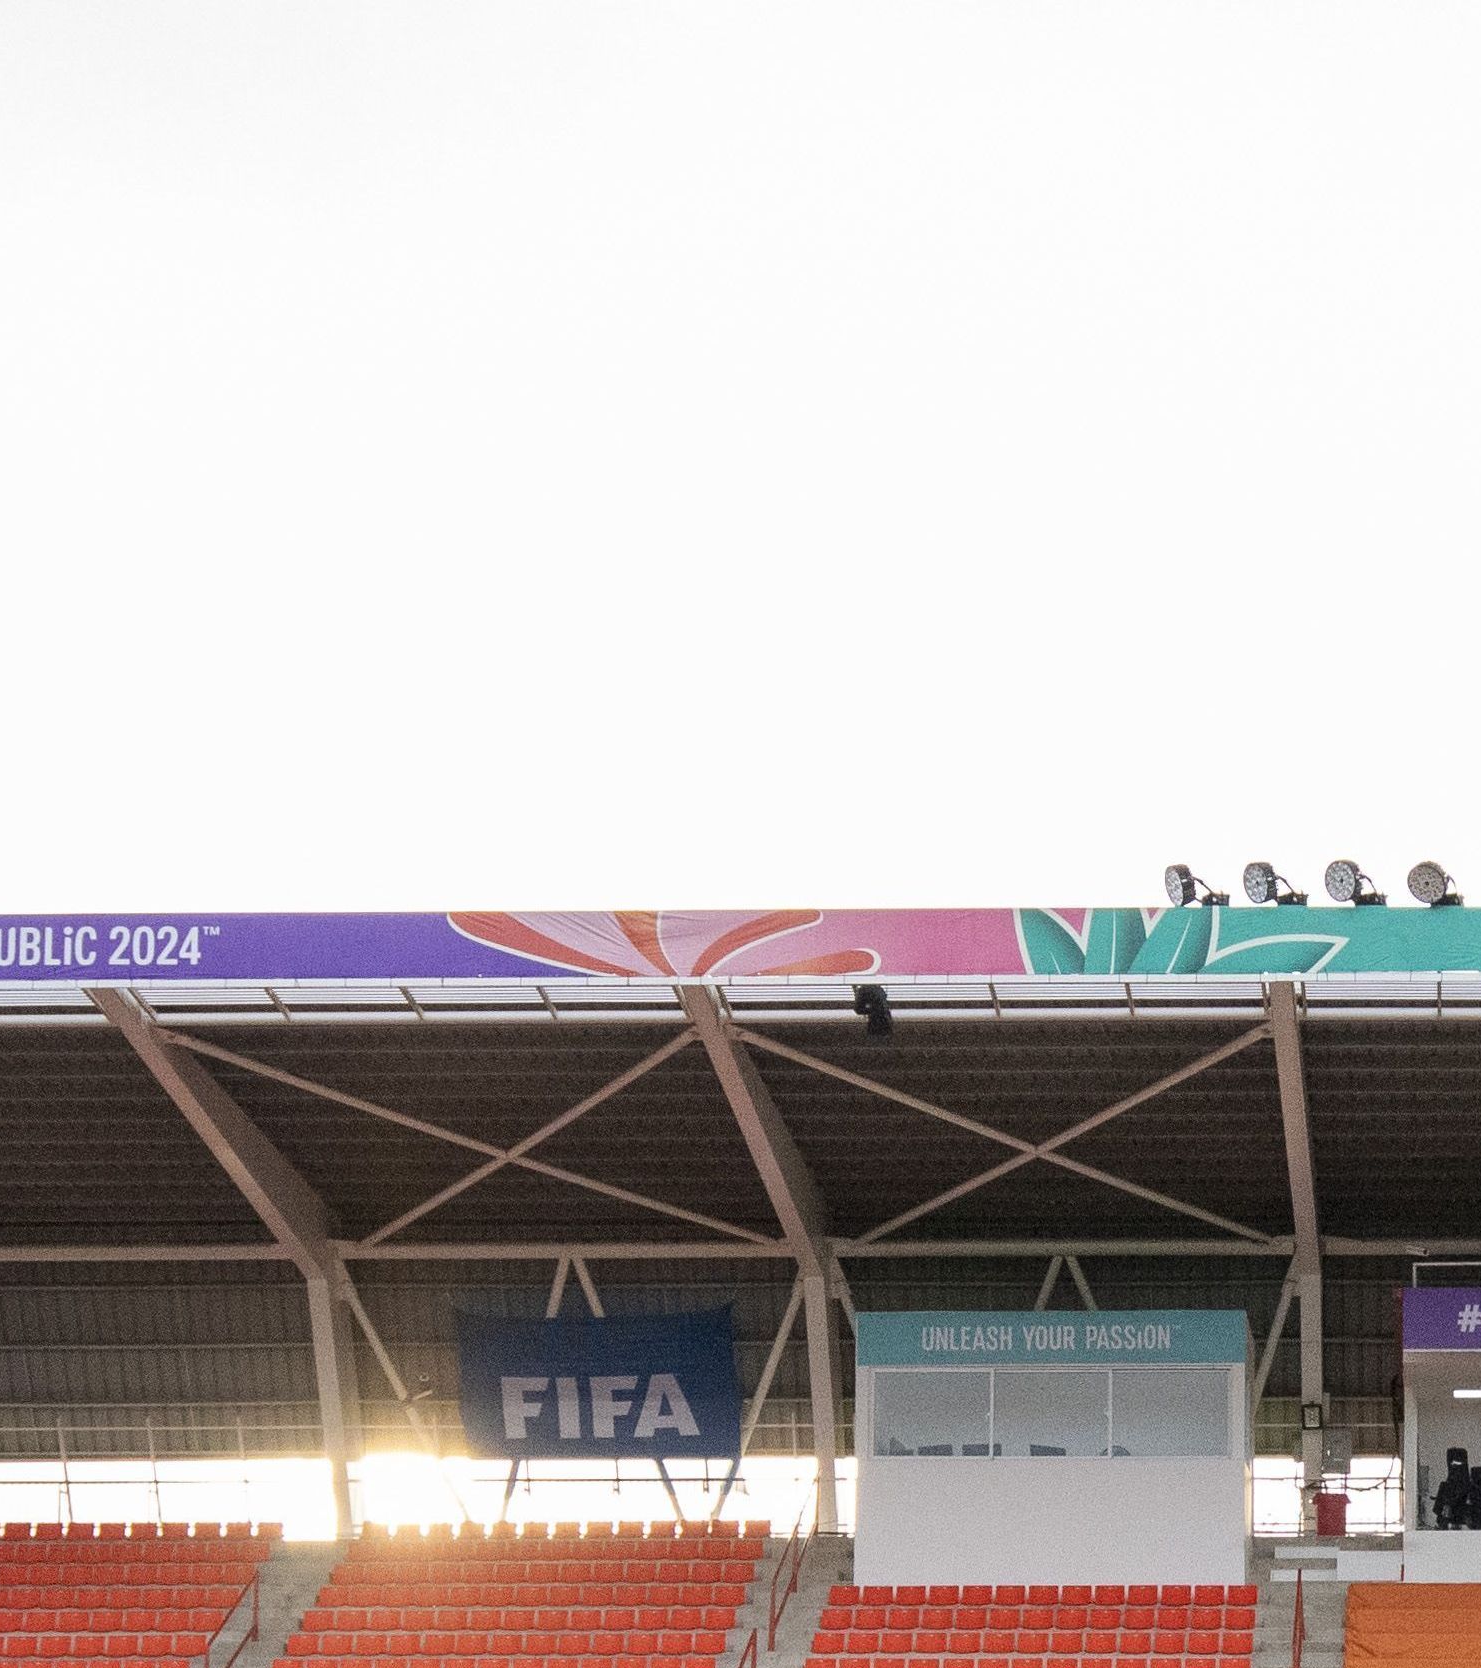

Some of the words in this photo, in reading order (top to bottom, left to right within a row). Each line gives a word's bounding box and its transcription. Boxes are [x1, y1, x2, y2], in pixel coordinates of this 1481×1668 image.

[921, 1325, 1013, 1351] UNLEASH
[1022, 1325, 1076, 1351] YOUR
[501, 1374, 701, 1439] FIFA
